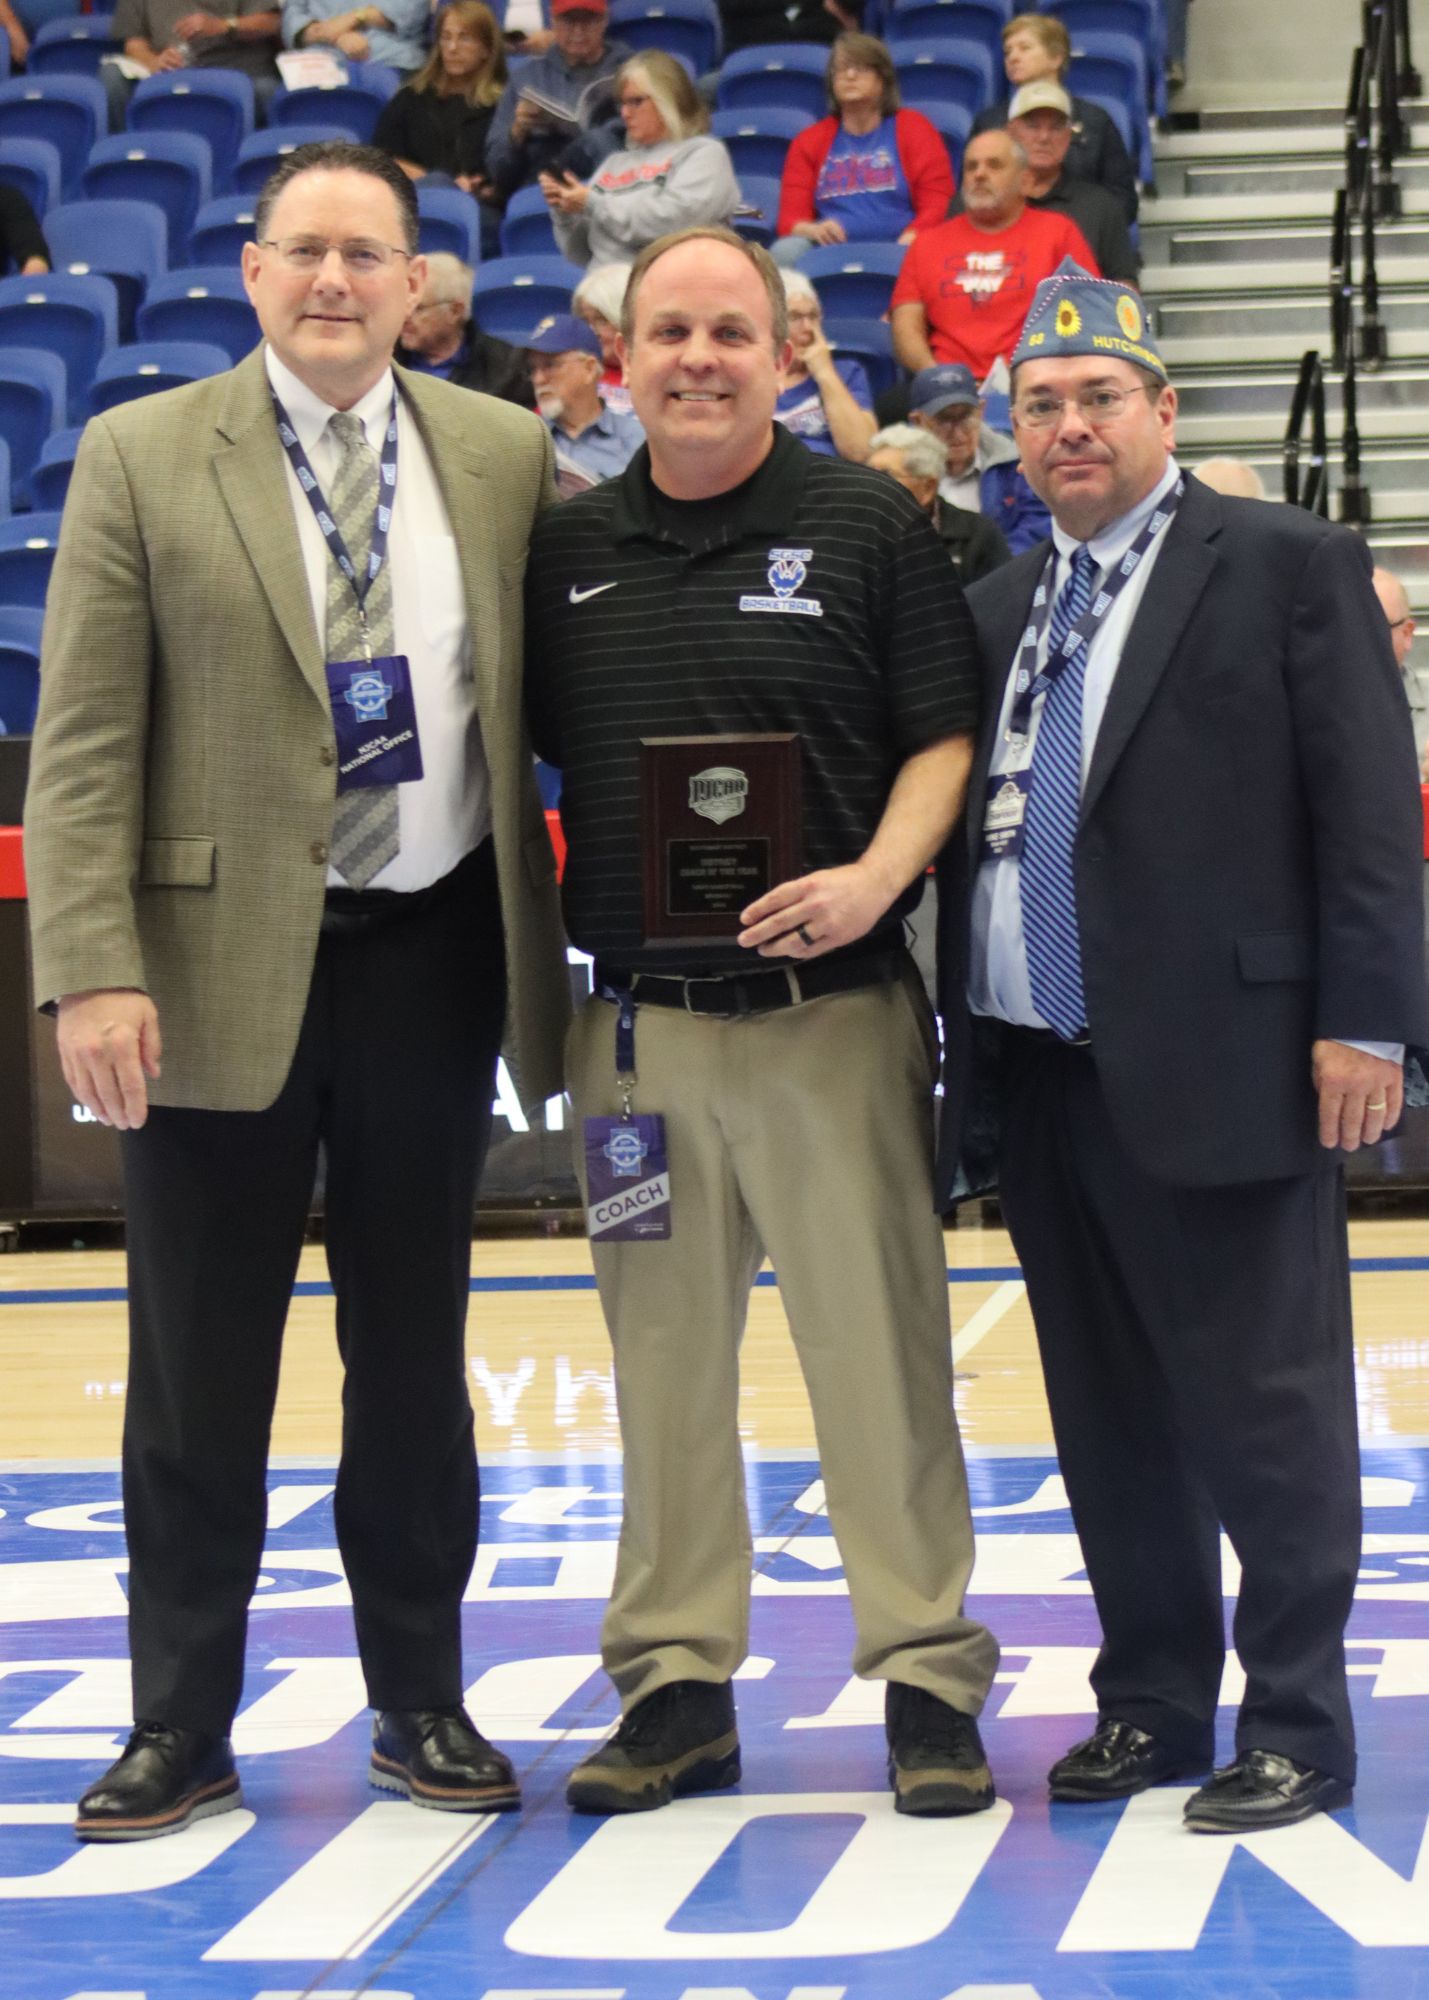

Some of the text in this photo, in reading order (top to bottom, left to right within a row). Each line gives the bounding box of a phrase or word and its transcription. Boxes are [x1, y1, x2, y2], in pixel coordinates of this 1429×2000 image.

[966, 250, 1004, 271] THE
[741, 597, 820, 614] BASKETBALL
[340, 729, 414, 774] NATIONAL OFFICE
[595, 1183, 664, 1223] COACH
